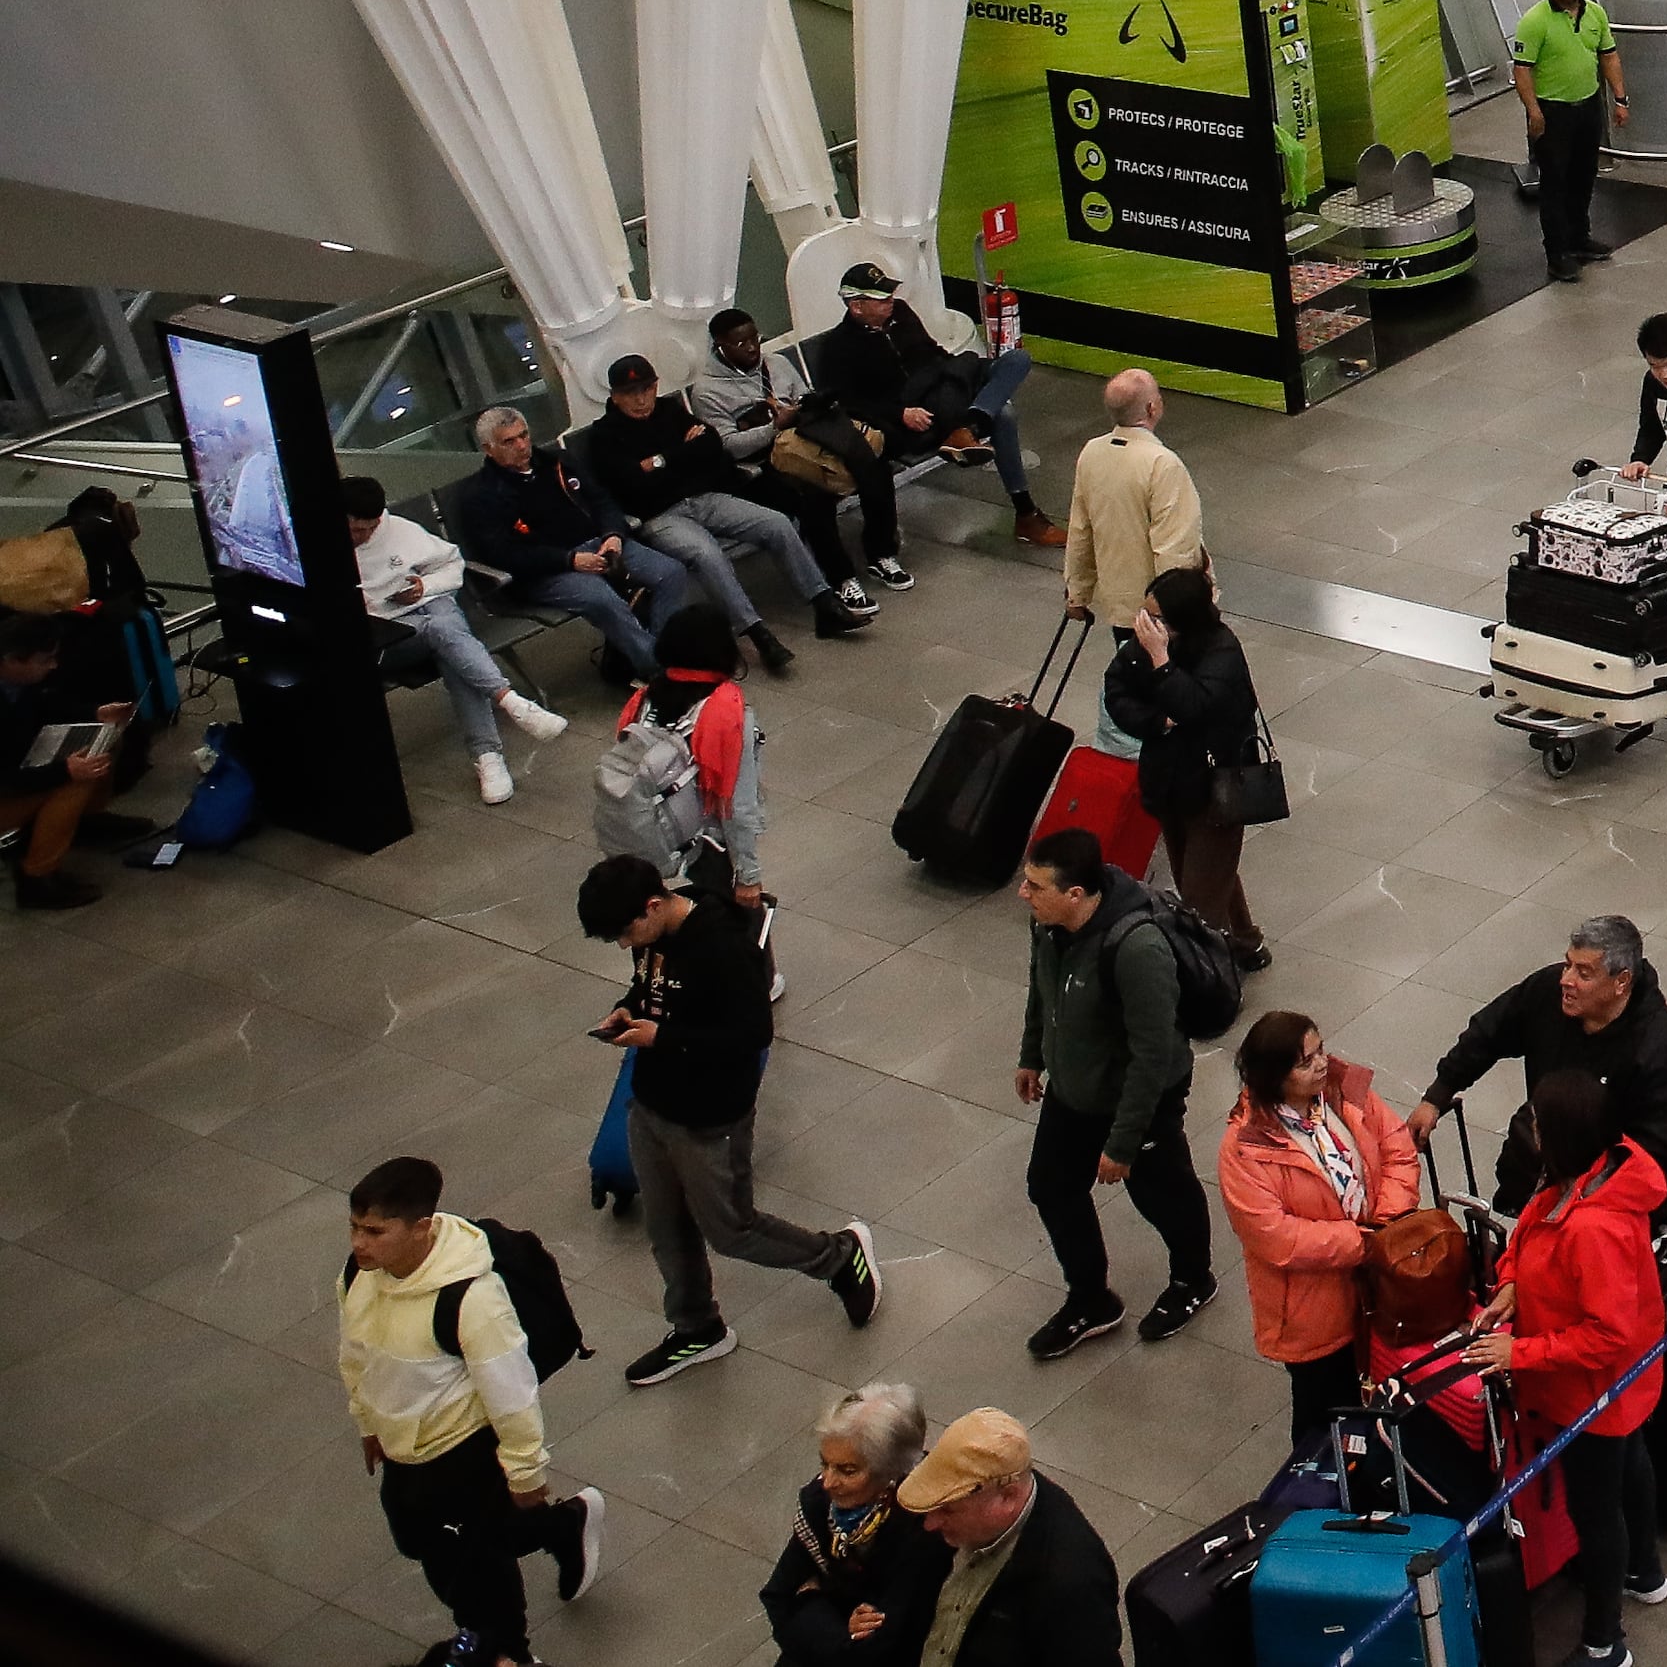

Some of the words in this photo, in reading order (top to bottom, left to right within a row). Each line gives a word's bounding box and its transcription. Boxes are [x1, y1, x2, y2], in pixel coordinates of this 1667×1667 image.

[1108, 107, 1166, 128] PROTECS
[1168, 115, 1173, 128] /
[1175, 117, 1245, 139] PROTEGGE
[1291, 79, 1308, 141] TrueStar
[1114, 158, 1165, 178] TRACKS
[1167, 166, 1172, 178] /
[1173, 167, 1249, 191] RINTRACCIA
[1121, 209, 1179, 230] ENSURES
[1181, 218, 1186, 231] /
[1187, 219, 1251, 242] ASSICURA
